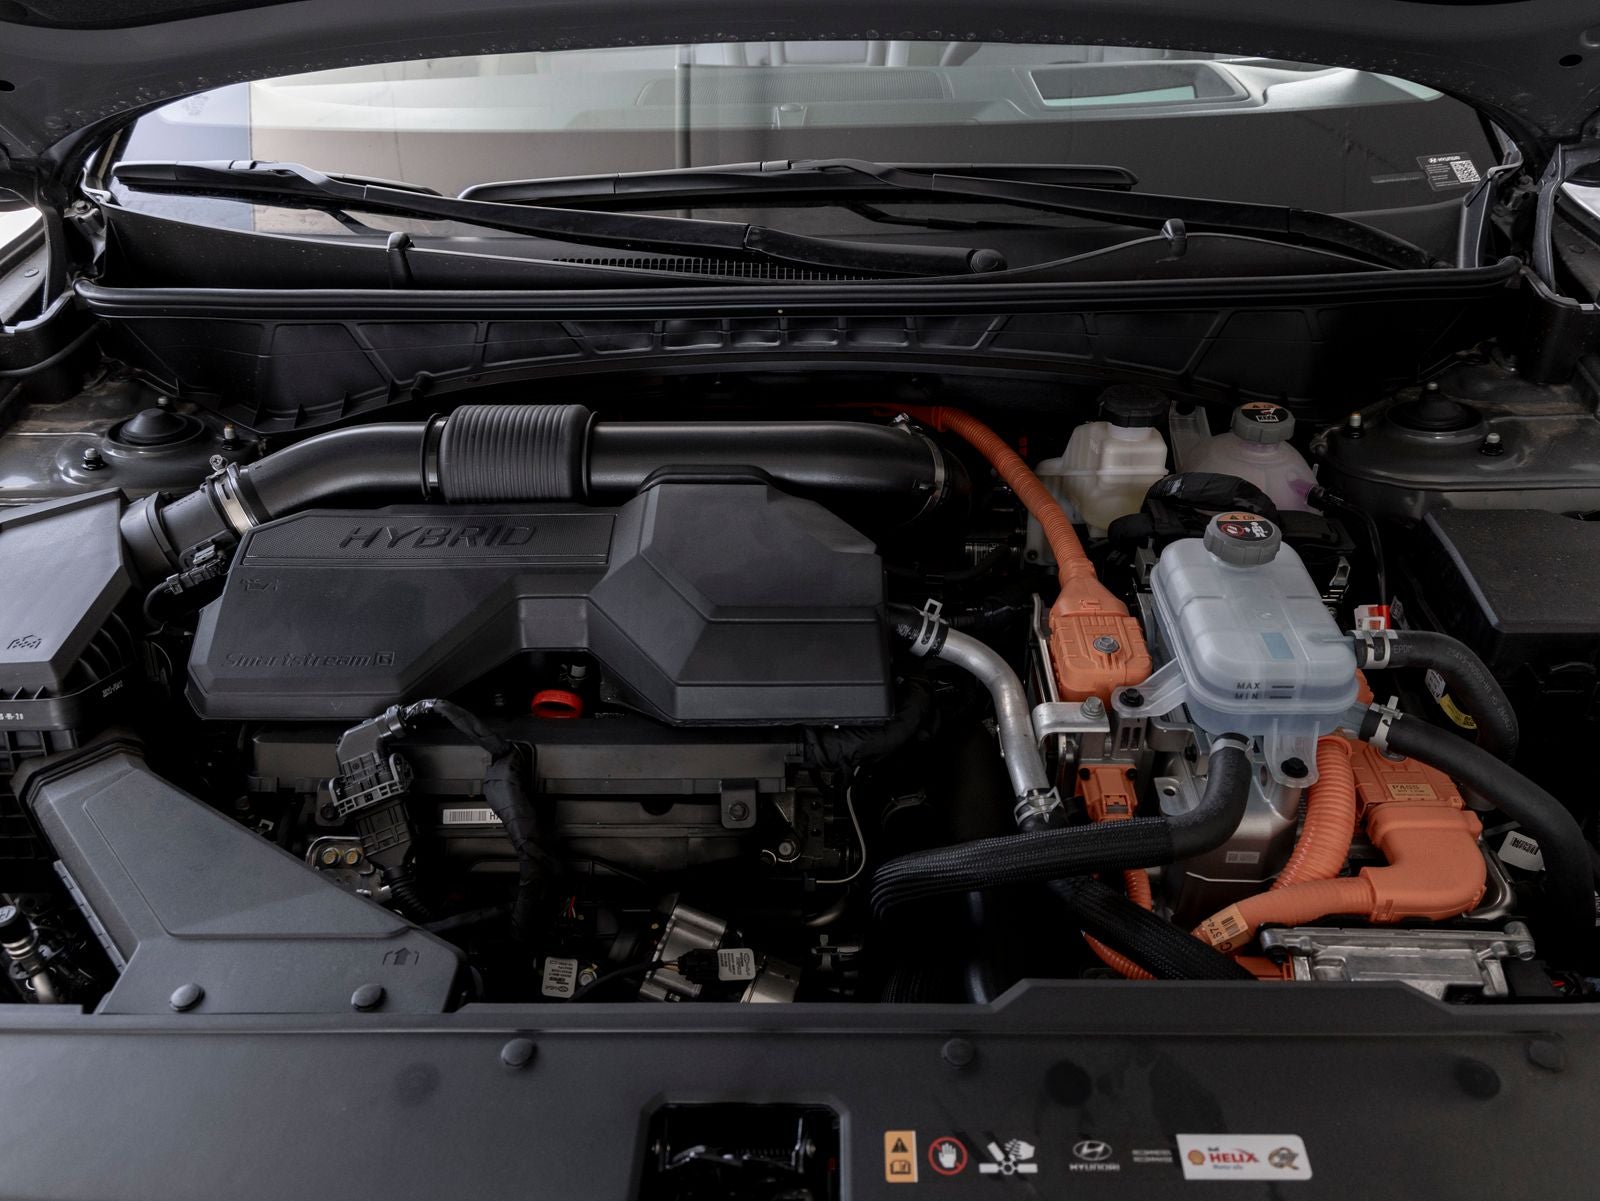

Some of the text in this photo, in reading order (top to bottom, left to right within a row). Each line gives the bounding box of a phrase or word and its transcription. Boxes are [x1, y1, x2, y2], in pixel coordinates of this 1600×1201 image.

[339, 525, 537, 549] HYBRID
[222, 650, 372, 668] Smartstream
[1236, 682, 1261, 690] MAX
[1234, 692, 1259, 700] MIN
[1208, 1152, 1259, 1163] HELIX
[1068, 1162, 1121, 1171] HYUNDAI
